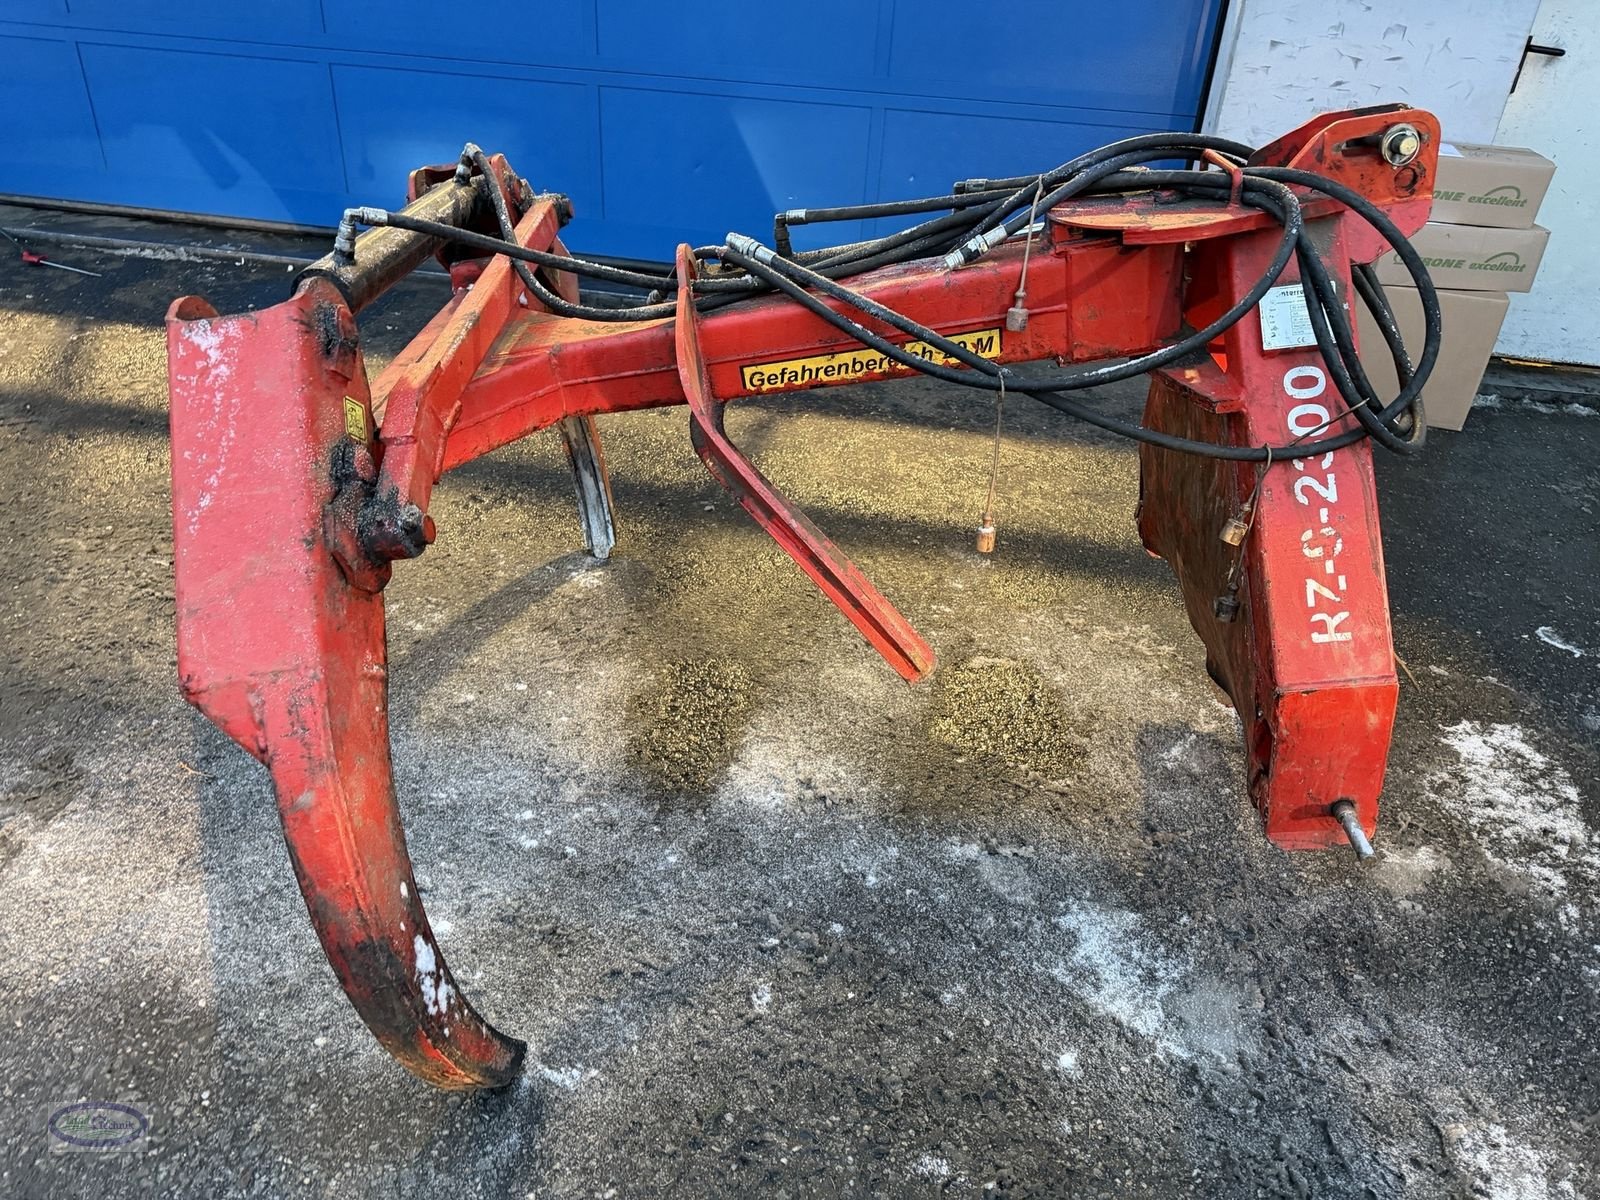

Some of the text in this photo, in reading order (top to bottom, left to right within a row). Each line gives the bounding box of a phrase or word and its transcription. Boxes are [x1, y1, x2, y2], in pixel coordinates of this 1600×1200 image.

[1433, 191, 1527, 207] ONE excellent
[1422, 257, 1526, 272] RONE excellent
[975, 336, 994, 354] M
